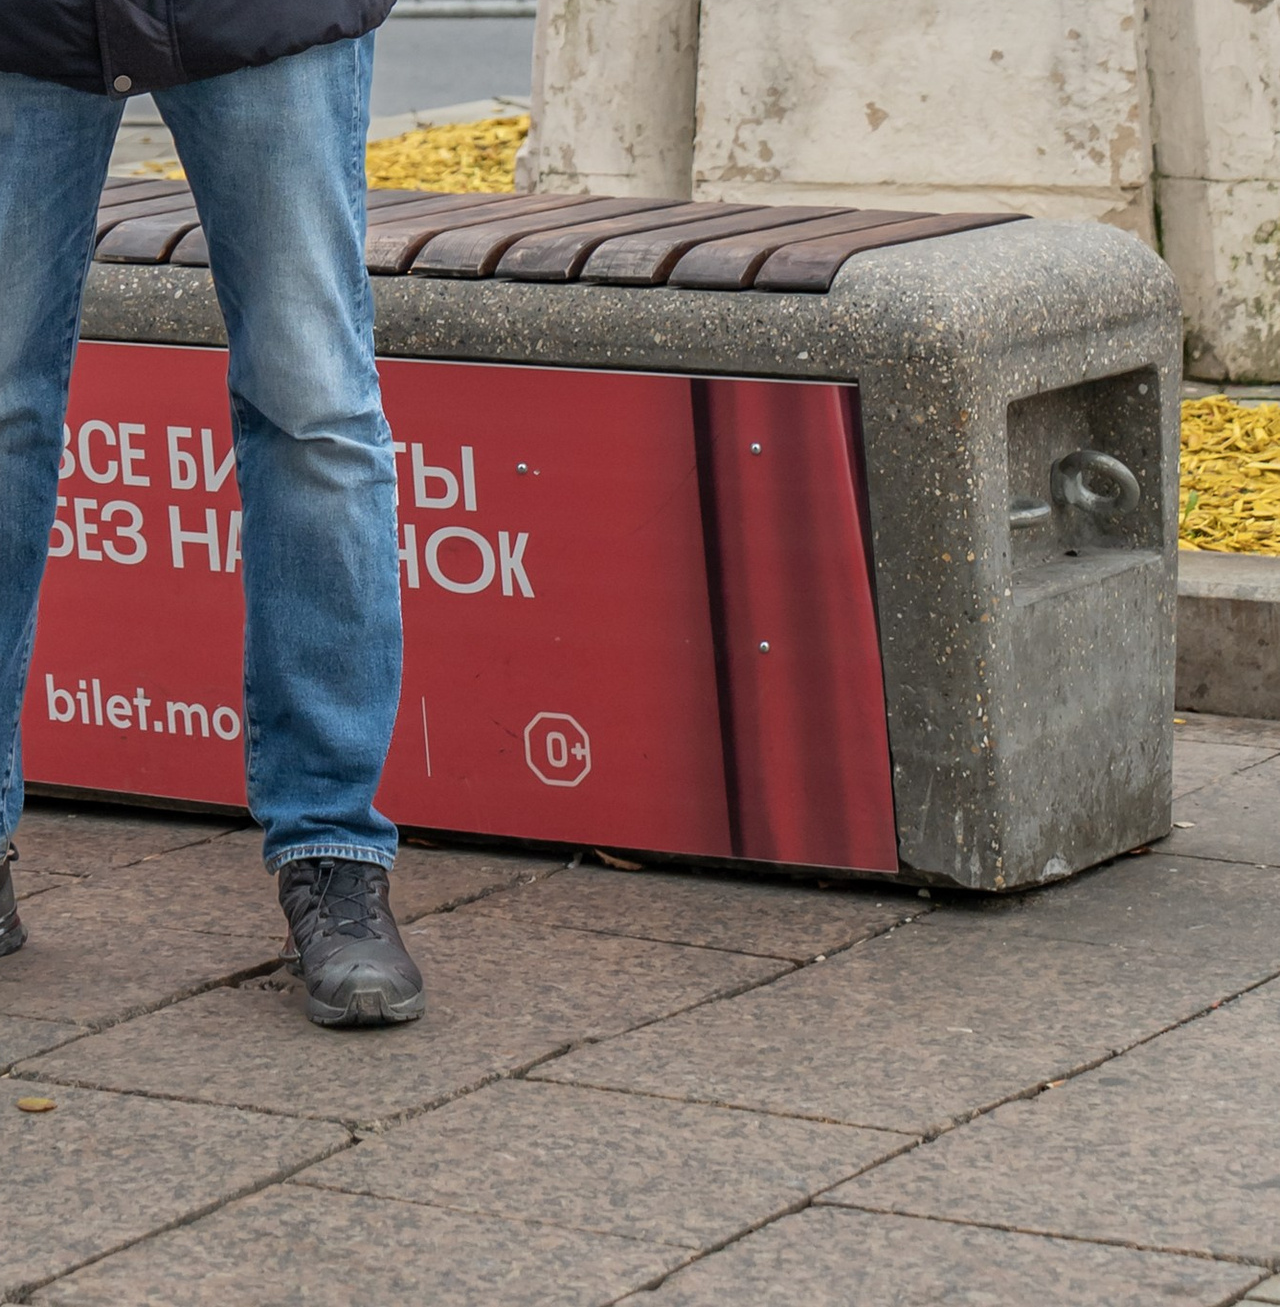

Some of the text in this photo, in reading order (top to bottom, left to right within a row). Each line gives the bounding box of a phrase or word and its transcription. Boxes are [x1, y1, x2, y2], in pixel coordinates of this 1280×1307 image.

[58, 419, 150, 487] ВСЕ
[48, 496, 147, 565] БЕЗ
[546, 731, 588, 768] 0+
